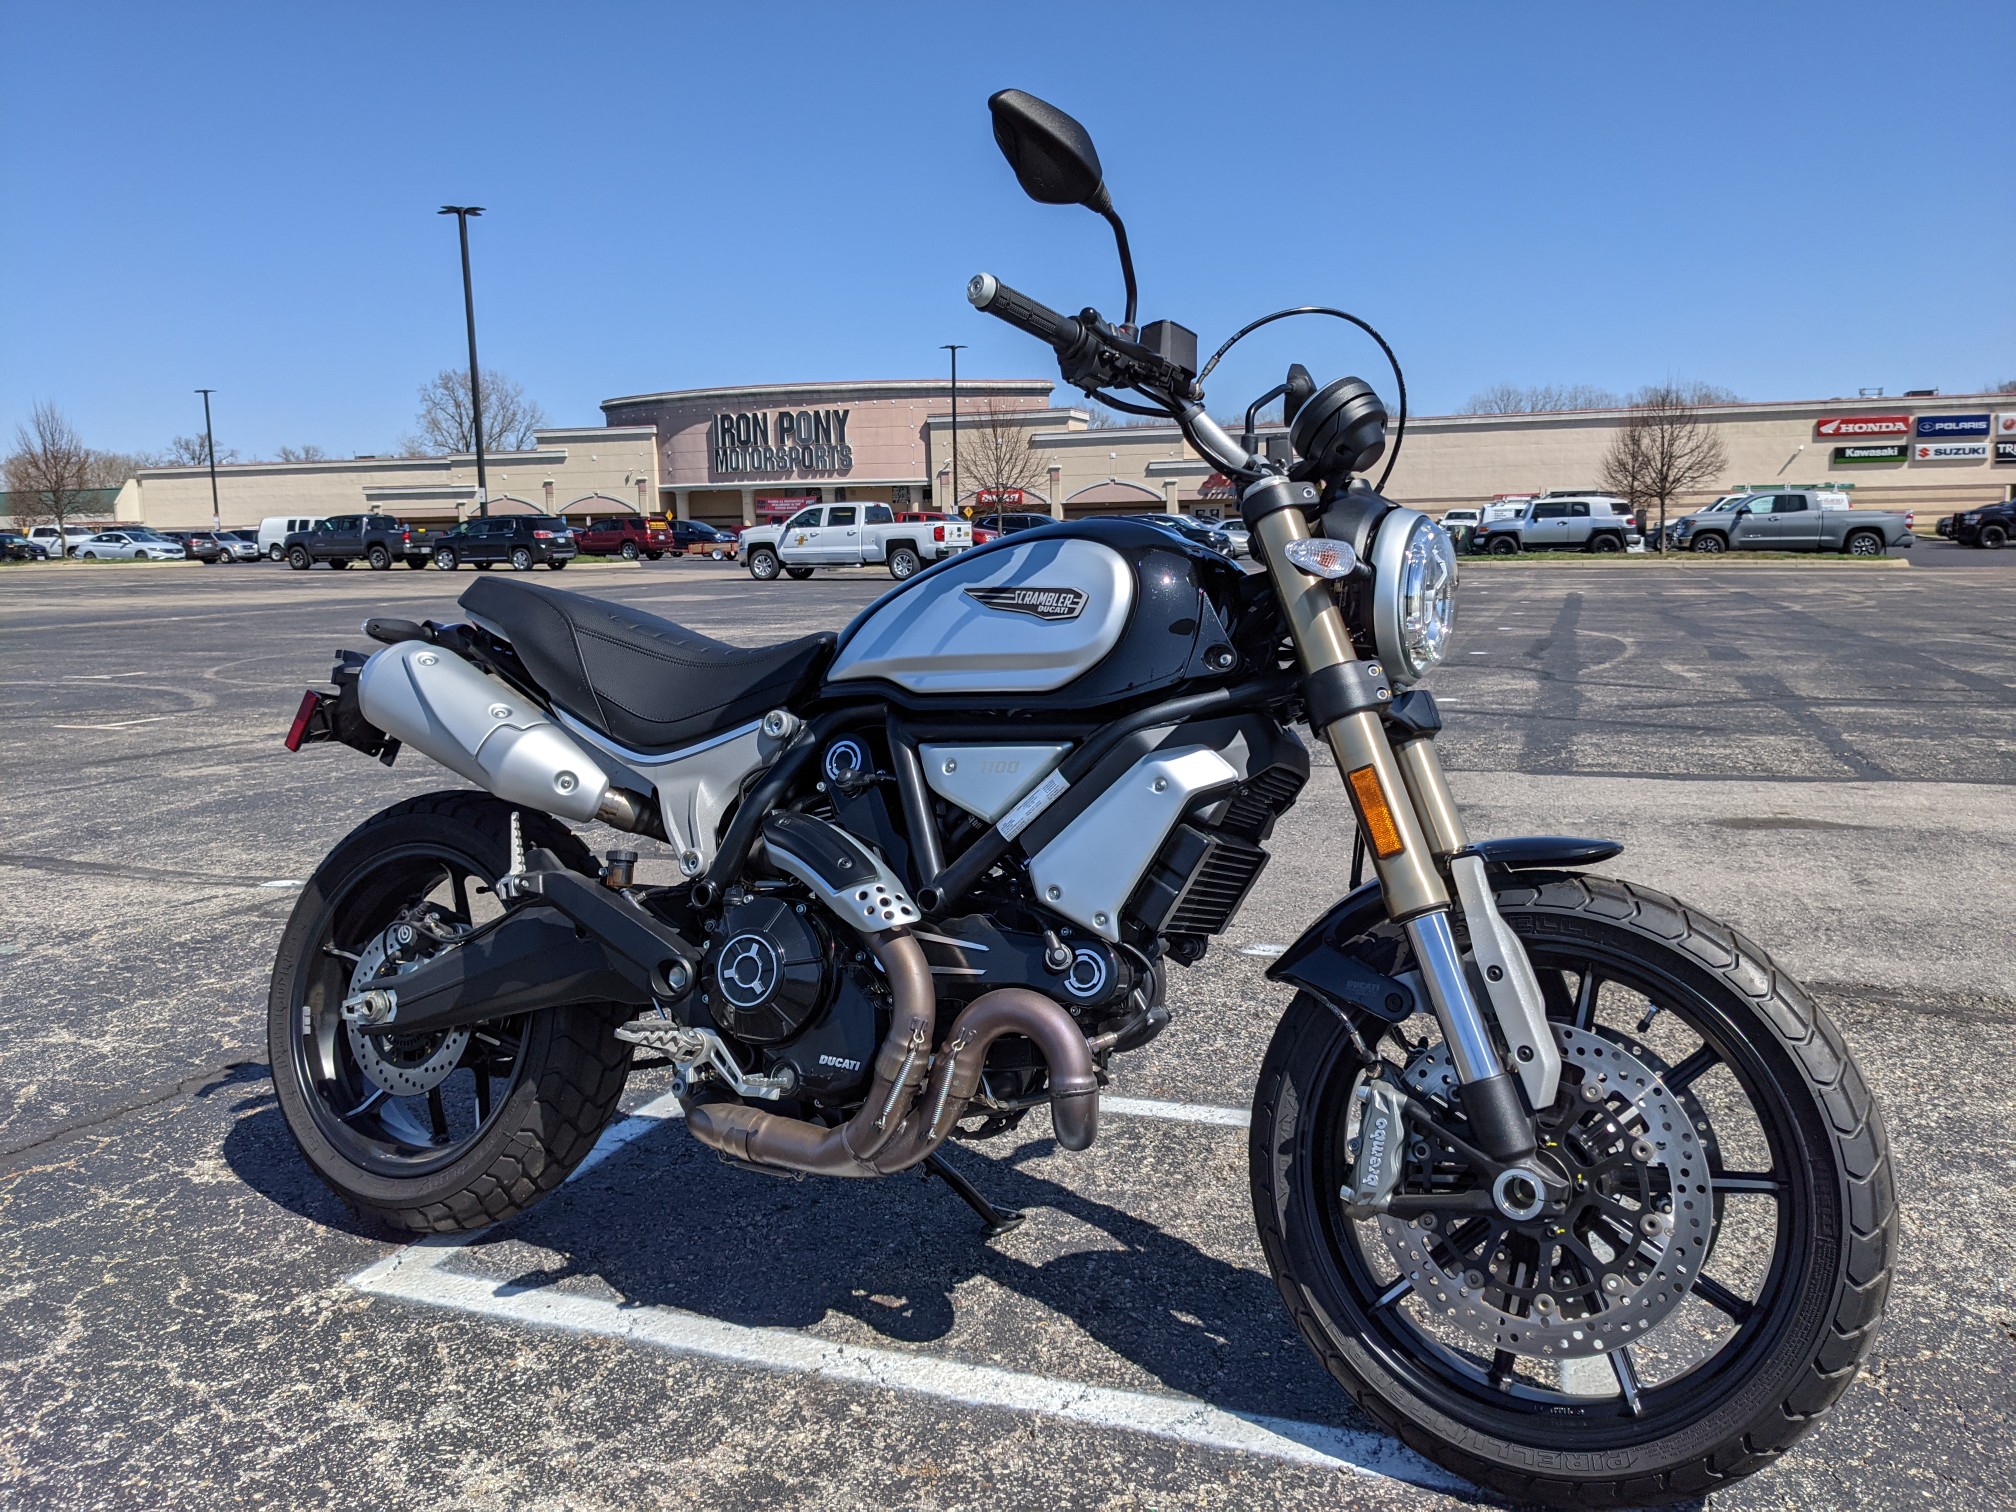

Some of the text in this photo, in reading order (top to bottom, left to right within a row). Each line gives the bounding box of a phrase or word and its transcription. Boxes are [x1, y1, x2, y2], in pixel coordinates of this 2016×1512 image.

[712, 409, 851, 448] IRON PONY
[1839, 421, 1908, 433] HONDA
[1934, 421, 1988, 431] POLARIS
[1845, 446, 1899, 458] Kawasaki
[1933, 447, 1986, 457] SUZUKI
[714, 445, 854, 474] MOTORSPORTS
[1014, 590, 1074, 608] SCRAMBLER
[1037, 605, 1069, 615] DUCATI
[980, 760, 1020, 774] 1100
[818, 1054, 862, 1071] DUCATI
[1362, 1117, 1388, 1187] brembo
